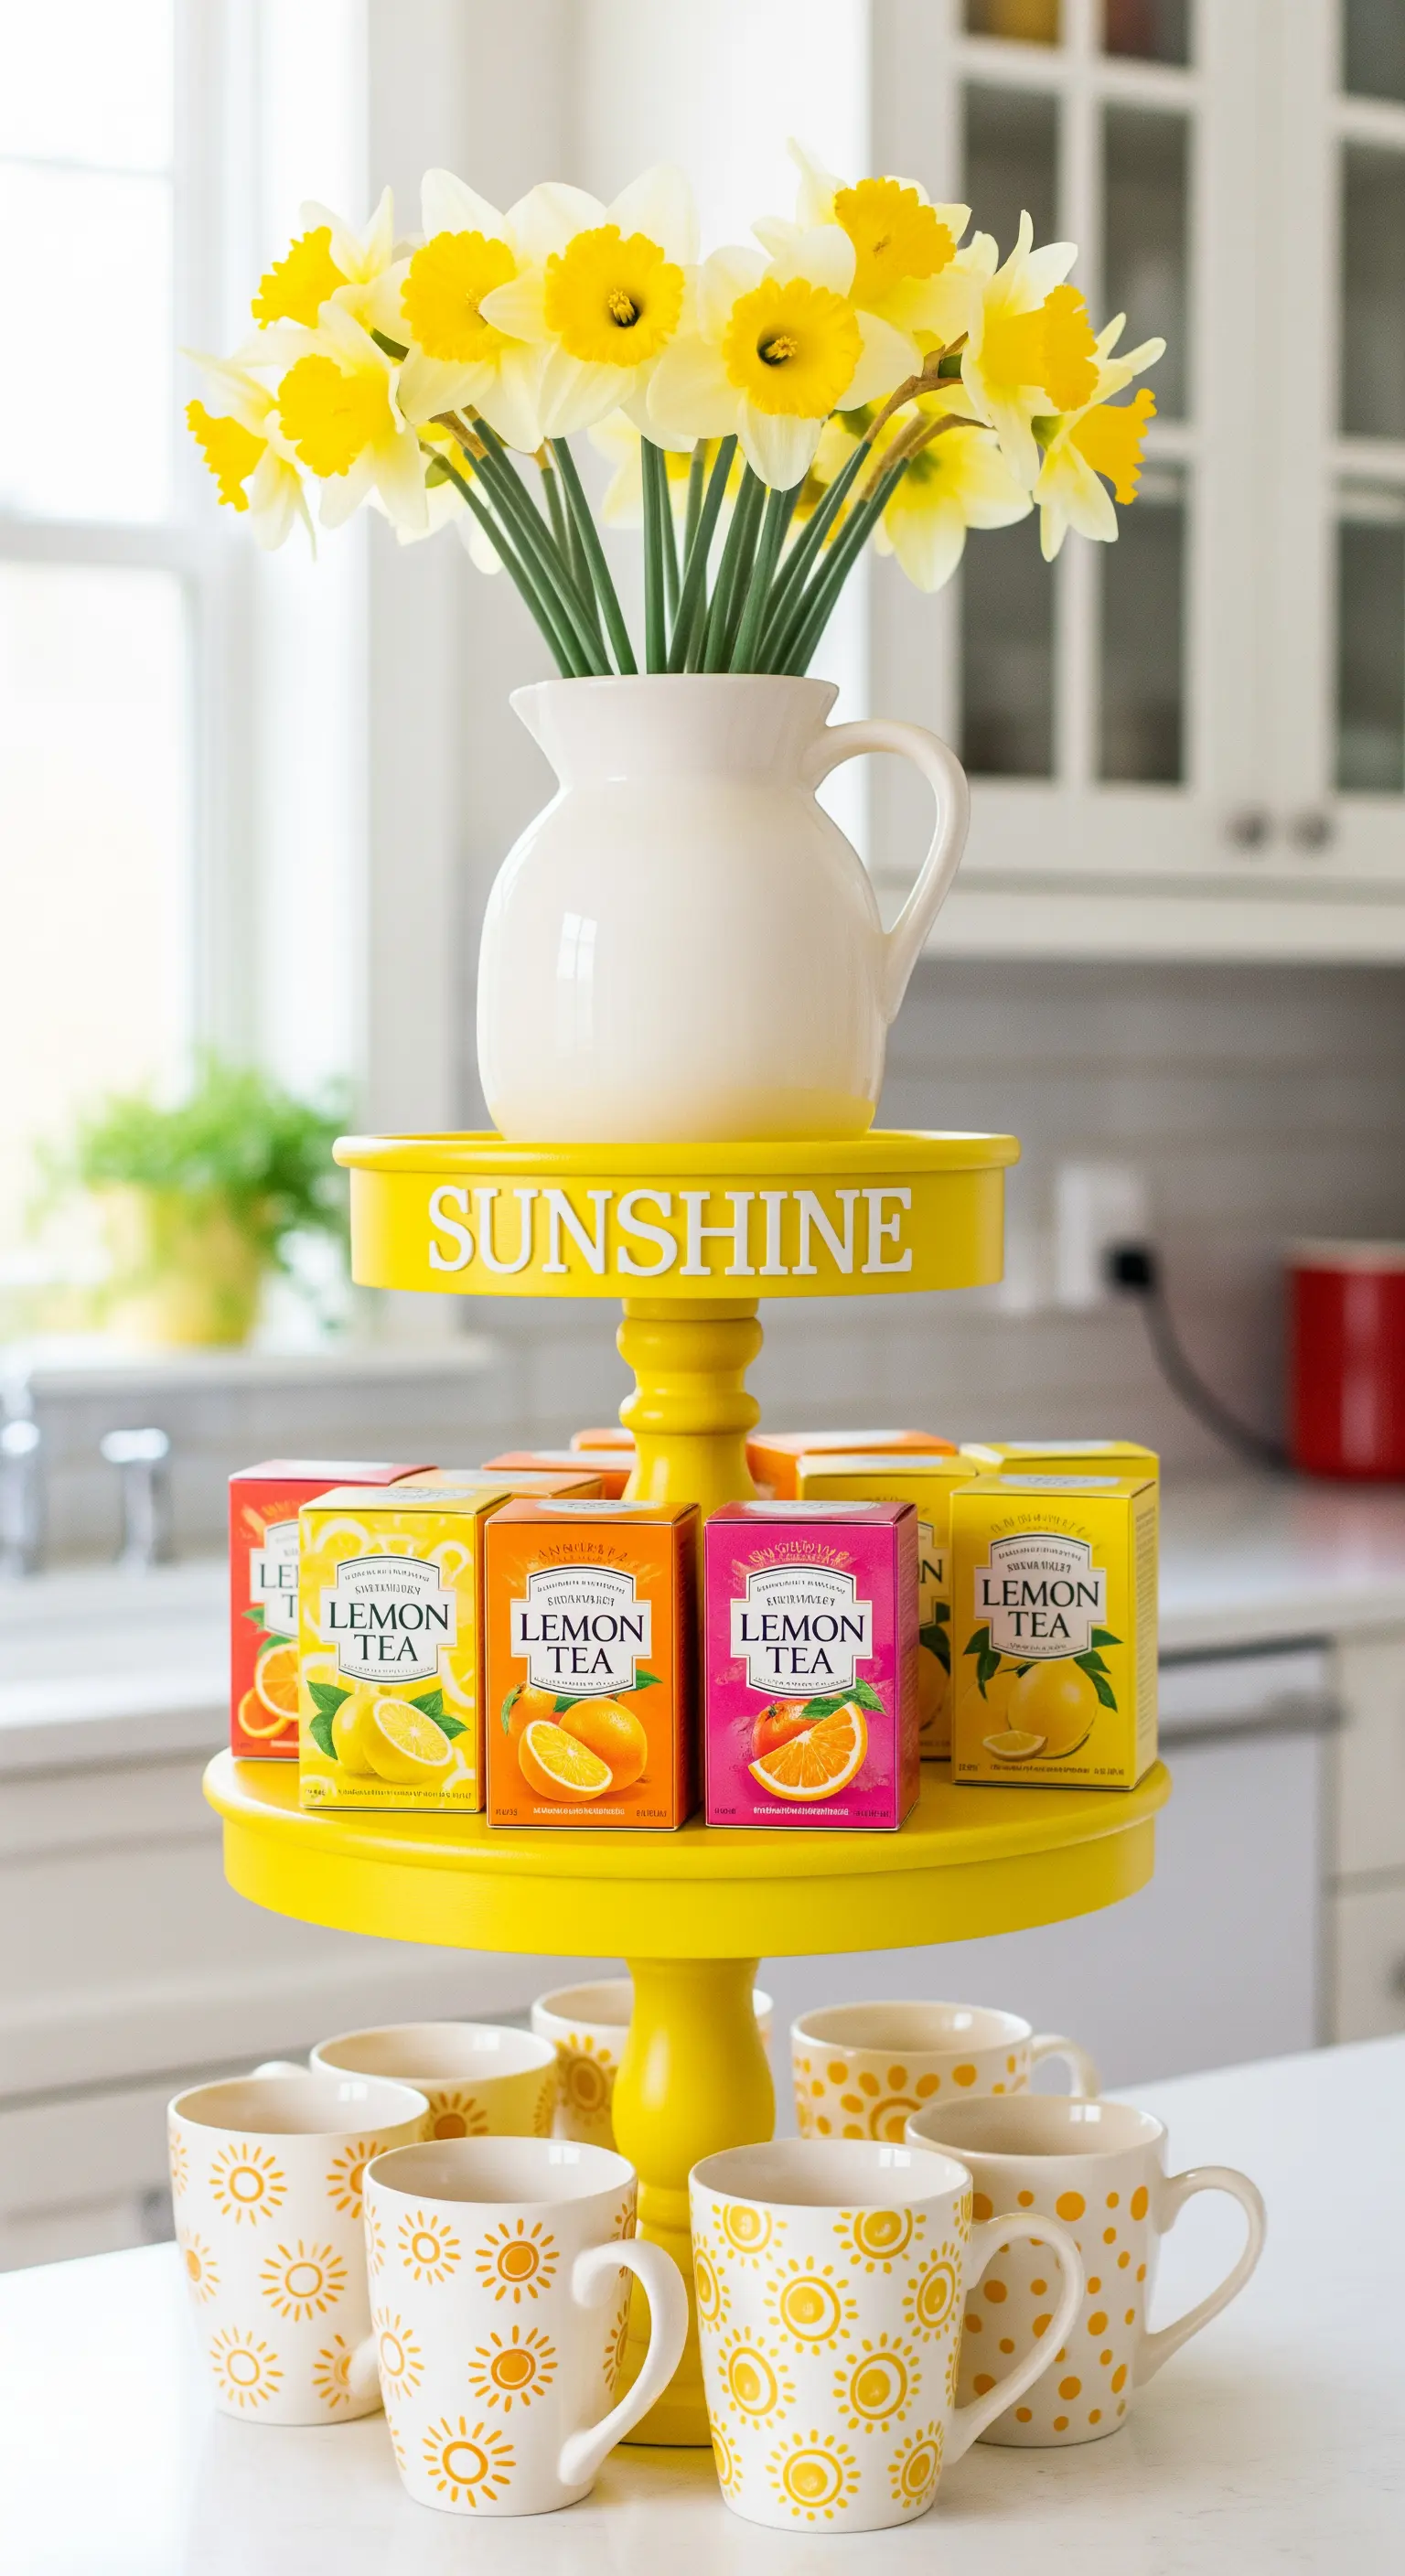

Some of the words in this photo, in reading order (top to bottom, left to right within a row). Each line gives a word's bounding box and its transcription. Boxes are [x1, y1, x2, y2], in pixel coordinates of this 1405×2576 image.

[428, 1185, 913, 1276] SUNSHINE
[981, 1579, 1099, 1608] LEMON
[328, 1601, 450, 1631] LEMON
[520, 1613, 645, 1643] LEMON
[740, 1613, 865, 1643] LEMON
[1007, 1611, 1071, 1638] TEA
[353, 1634, 419, 1662] TEA
[546, 1646, 615, 1674] TEA
[766, 1646, 834, 1674] TEA
